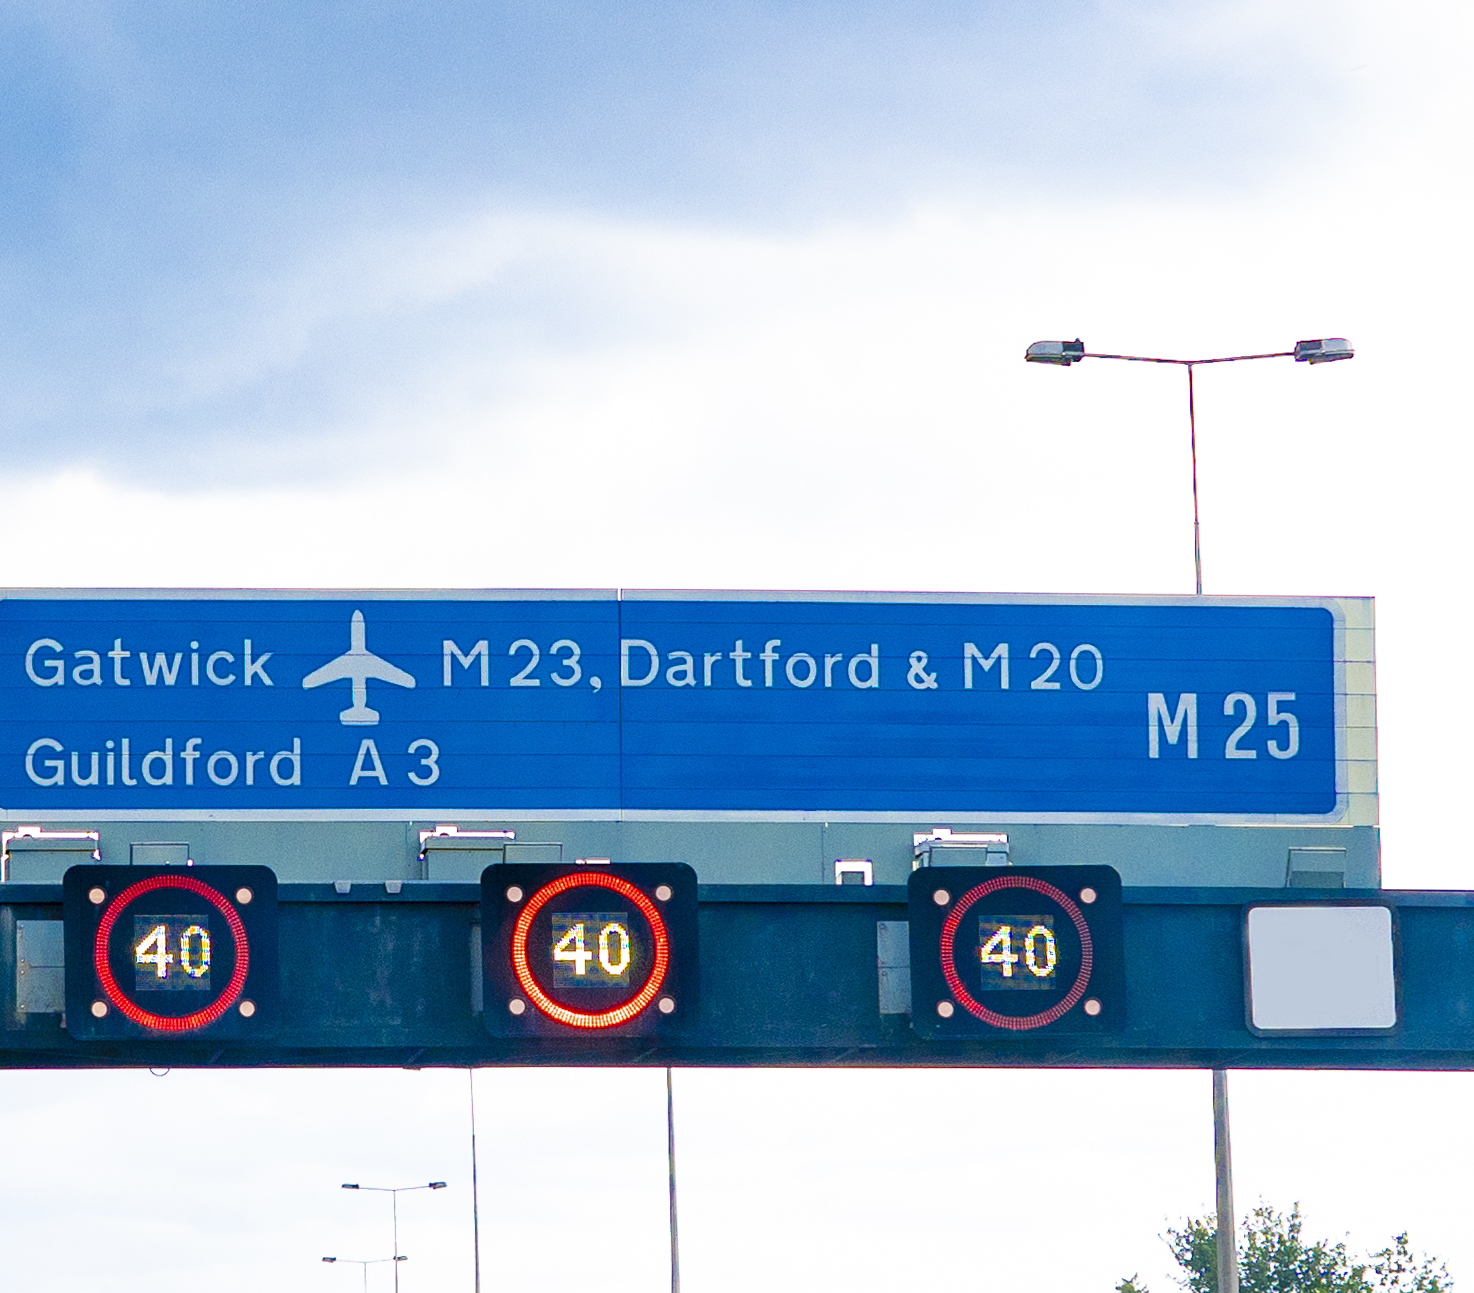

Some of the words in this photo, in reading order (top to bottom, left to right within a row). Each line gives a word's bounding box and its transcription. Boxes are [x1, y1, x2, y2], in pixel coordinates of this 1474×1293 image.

[25, 638, 274, 687] Gatwick
[620, 639, 879, 689] Dartford
[907, 650, 938, 690] &
[25, 737, 301, 786] Guildford
[136, 924, 211, 977] 40
[553, 922, 631, 975] 40
[980, 925, 1057, 976] 40
